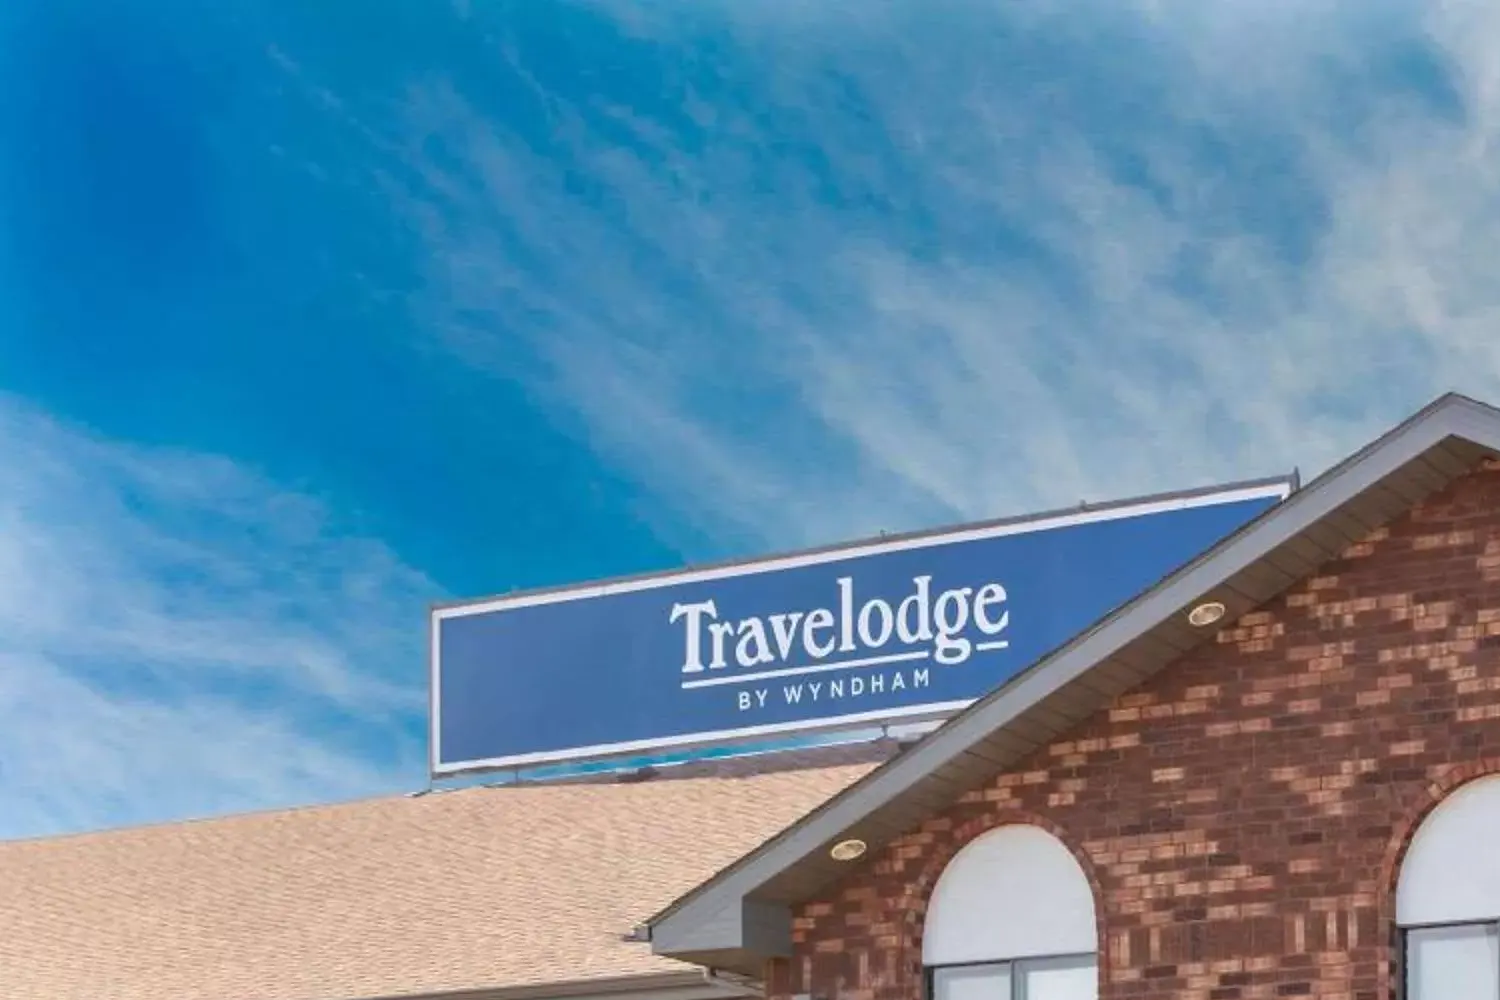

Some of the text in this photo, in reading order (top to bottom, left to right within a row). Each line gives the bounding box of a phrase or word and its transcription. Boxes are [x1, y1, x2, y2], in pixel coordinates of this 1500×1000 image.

[668, 575, 1010, 674] Travelodge
[738, 667, 931, 711] BY WYNDHAM
